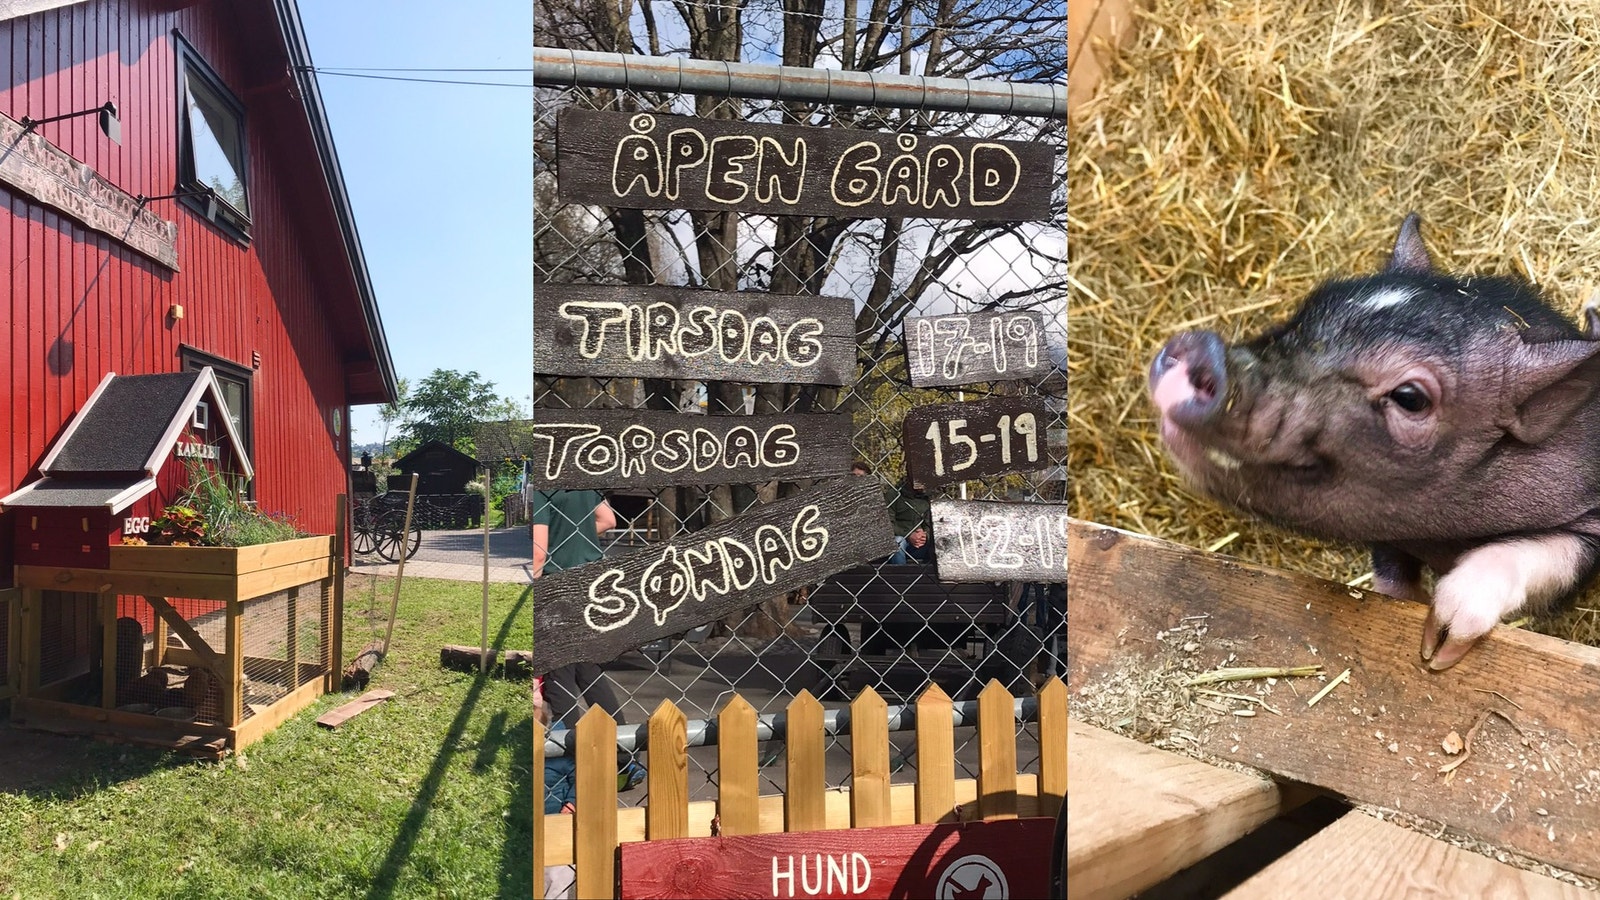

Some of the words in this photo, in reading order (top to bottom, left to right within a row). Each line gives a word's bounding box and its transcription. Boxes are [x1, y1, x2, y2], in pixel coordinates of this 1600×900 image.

[2, 121, 79, 188] KAMPEN
[612, 113, 807, 205] ÅPEN
[831, 133, 1021, 207] GÅRD
[559, 301, 824, 367] TIRSDAG
[917, 316, 1038, 380] 17-19
[533, 423, 800, 480] TORSDAG
[925, 412, 1038, 477] 15-19
[123, 517, 150, 535] EGG
[583, 504, 829, 633] SØNDAG
[771, 852, 872, 897] HUND
